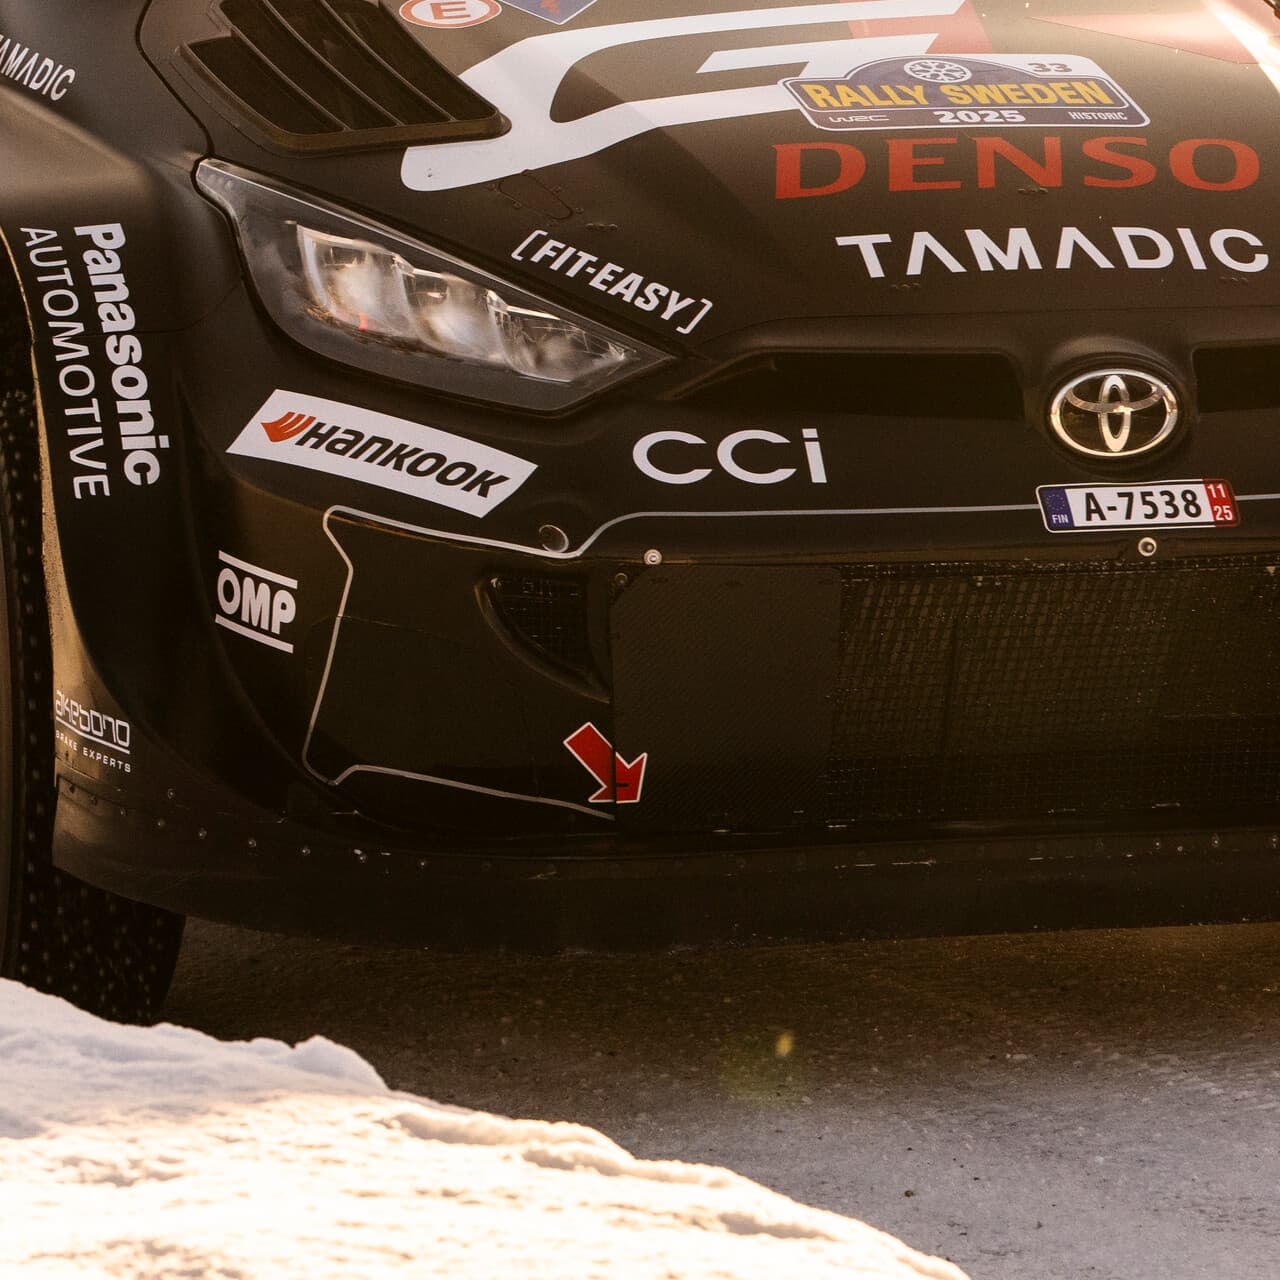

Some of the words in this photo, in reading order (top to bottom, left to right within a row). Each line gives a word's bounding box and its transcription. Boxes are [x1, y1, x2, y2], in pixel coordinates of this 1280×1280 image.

[1028, 62, 1073, 73] 33
[800, 84, 931, 108] RALLY
[939, 80, 1117, 107] SWEDEN
[934, 110, 1027, 124] 2025
[773, 135, 1262, 200] DENSO
[835, 225, 1271, 278] TAMADIC
[21, 226, 111, 500] AUTOMOTIVE
[74, 222, 171, 487] Panasonic
[1052, 514, 1069, 524] FIN
[1084, 489, 1202, 522] A-7538
[1207, 483, 1227, 499] 11
[1213, 505, 1234, 521] 25
[216, 568, 298, 637] OMP
[55, 730, 78, 751] BRAKE
[82, 746, 131, 773] EXPERTS
